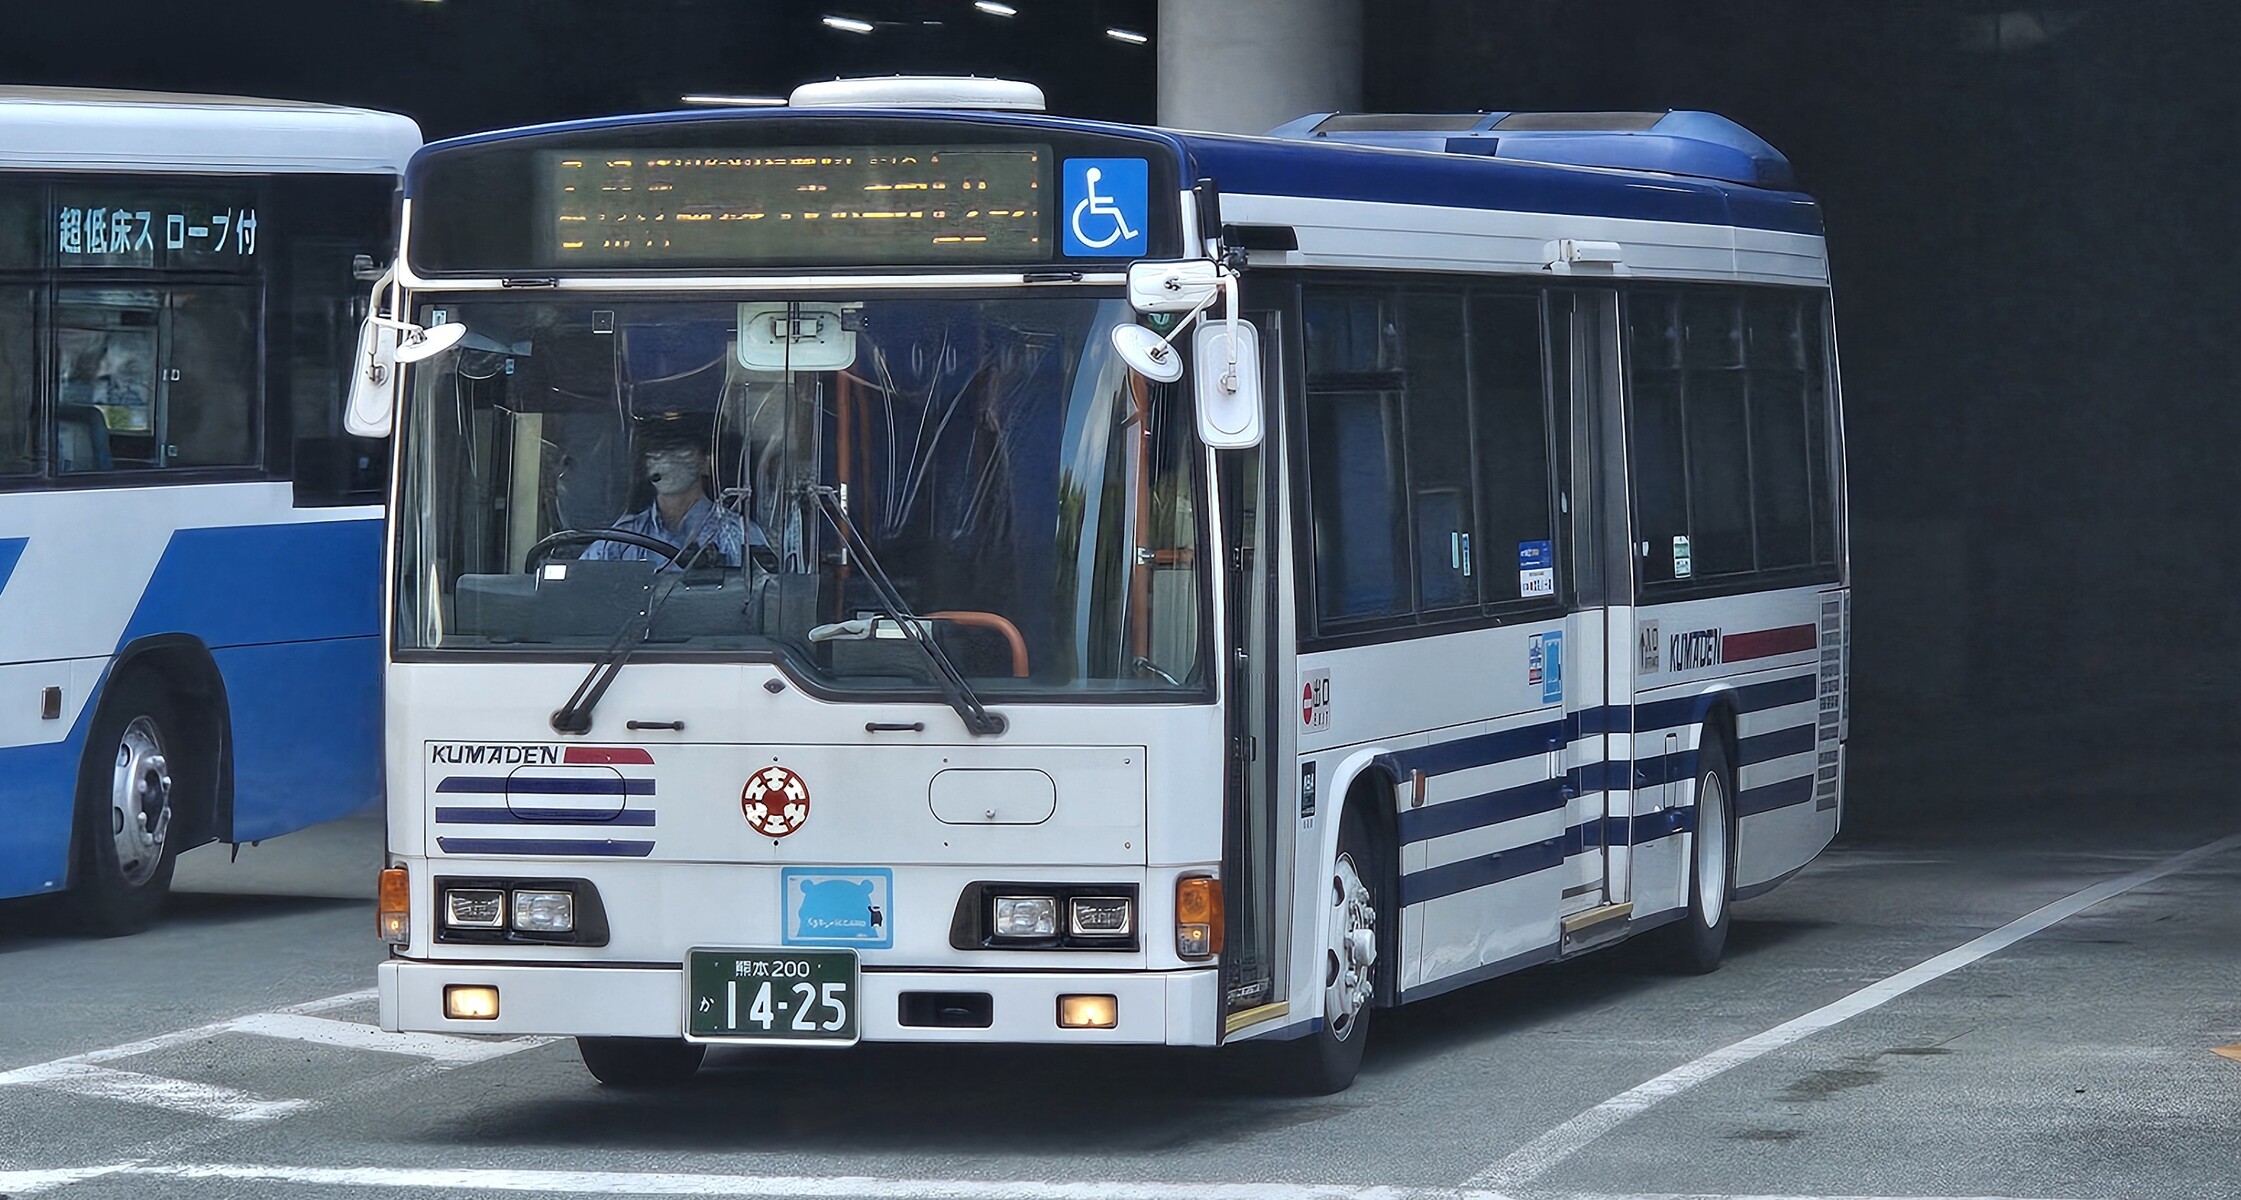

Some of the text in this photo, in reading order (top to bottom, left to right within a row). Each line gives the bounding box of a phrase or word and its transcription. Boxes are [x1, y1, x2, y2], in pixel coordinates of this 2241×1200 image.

[1669, 627, 1722, 673] KUMADEN
[1313, 678, 1330, 707] 出口
[432, 745, 559, 764] KUMADEN
[699, 980, 847, 1031] か 14-25
